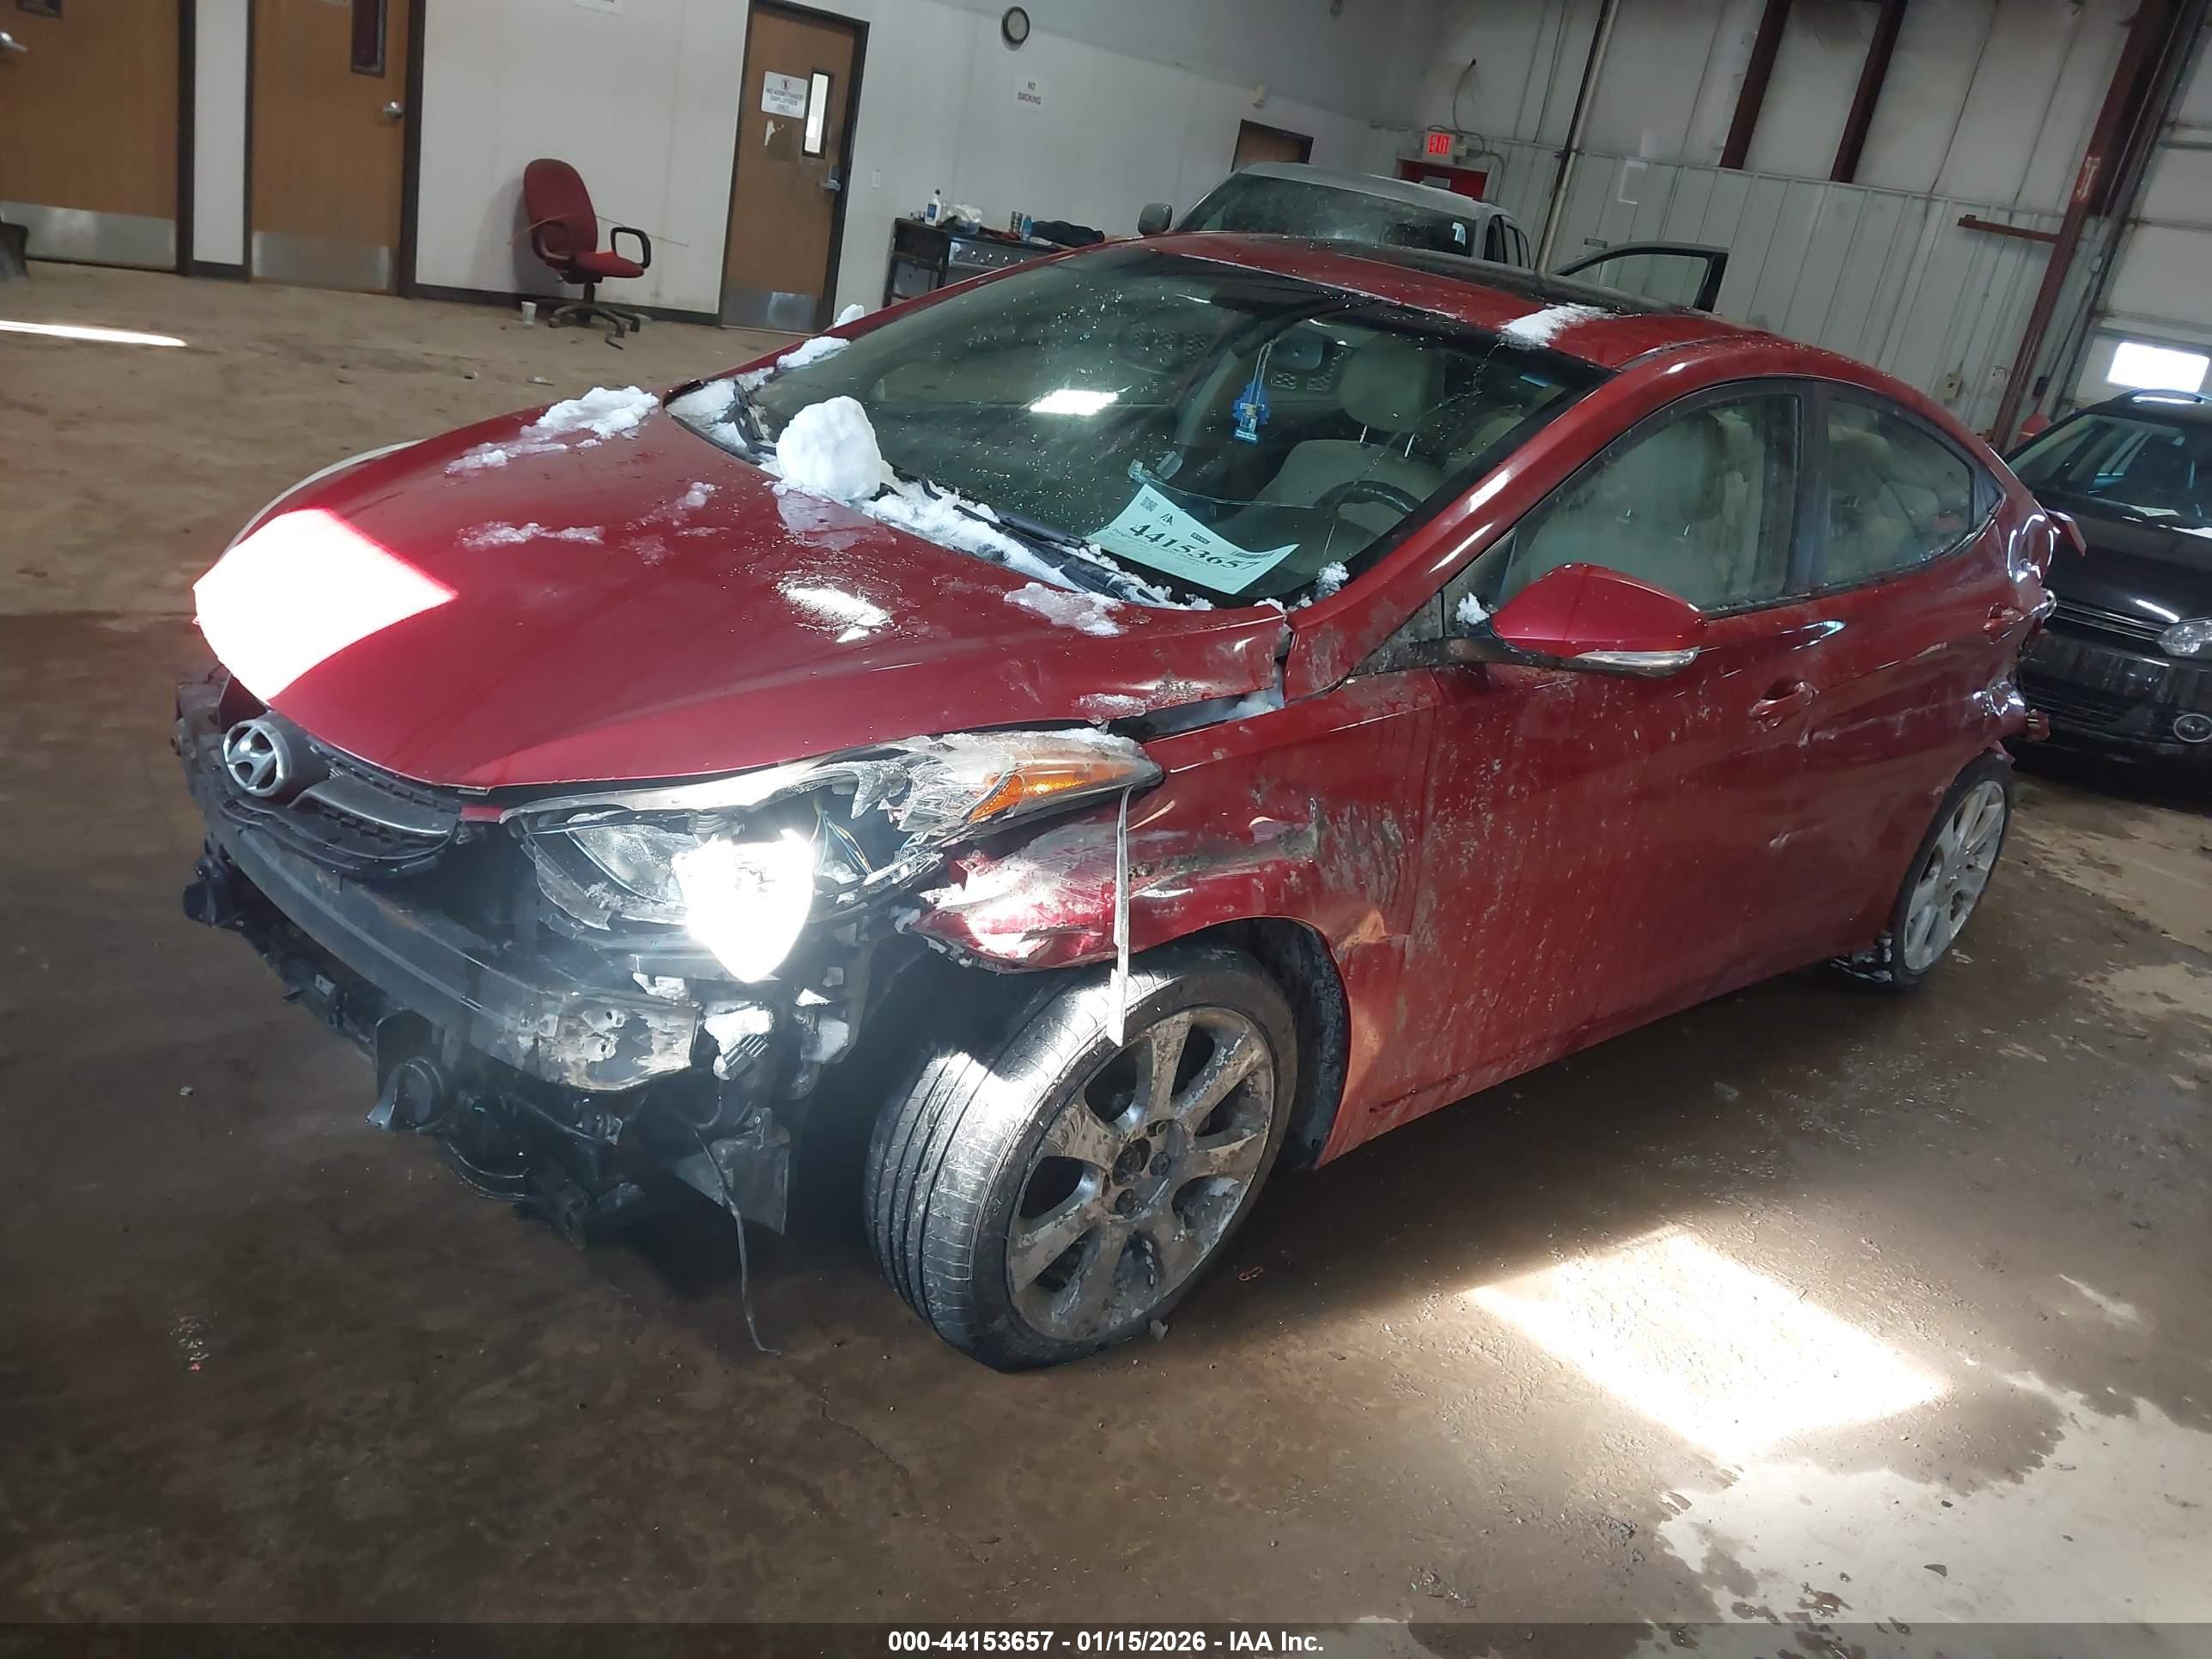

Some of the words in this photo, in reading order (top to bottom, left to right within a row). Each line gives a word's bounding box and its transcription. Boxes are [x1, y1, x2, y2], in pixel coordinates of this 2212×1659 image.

[1027, 82, 1036, 90] NO
[1018, 91, 1042, 105] SMOKING
[1429, 134, 1450, 155] EXIT
[1129, 524, 1261, 570] 44153657
